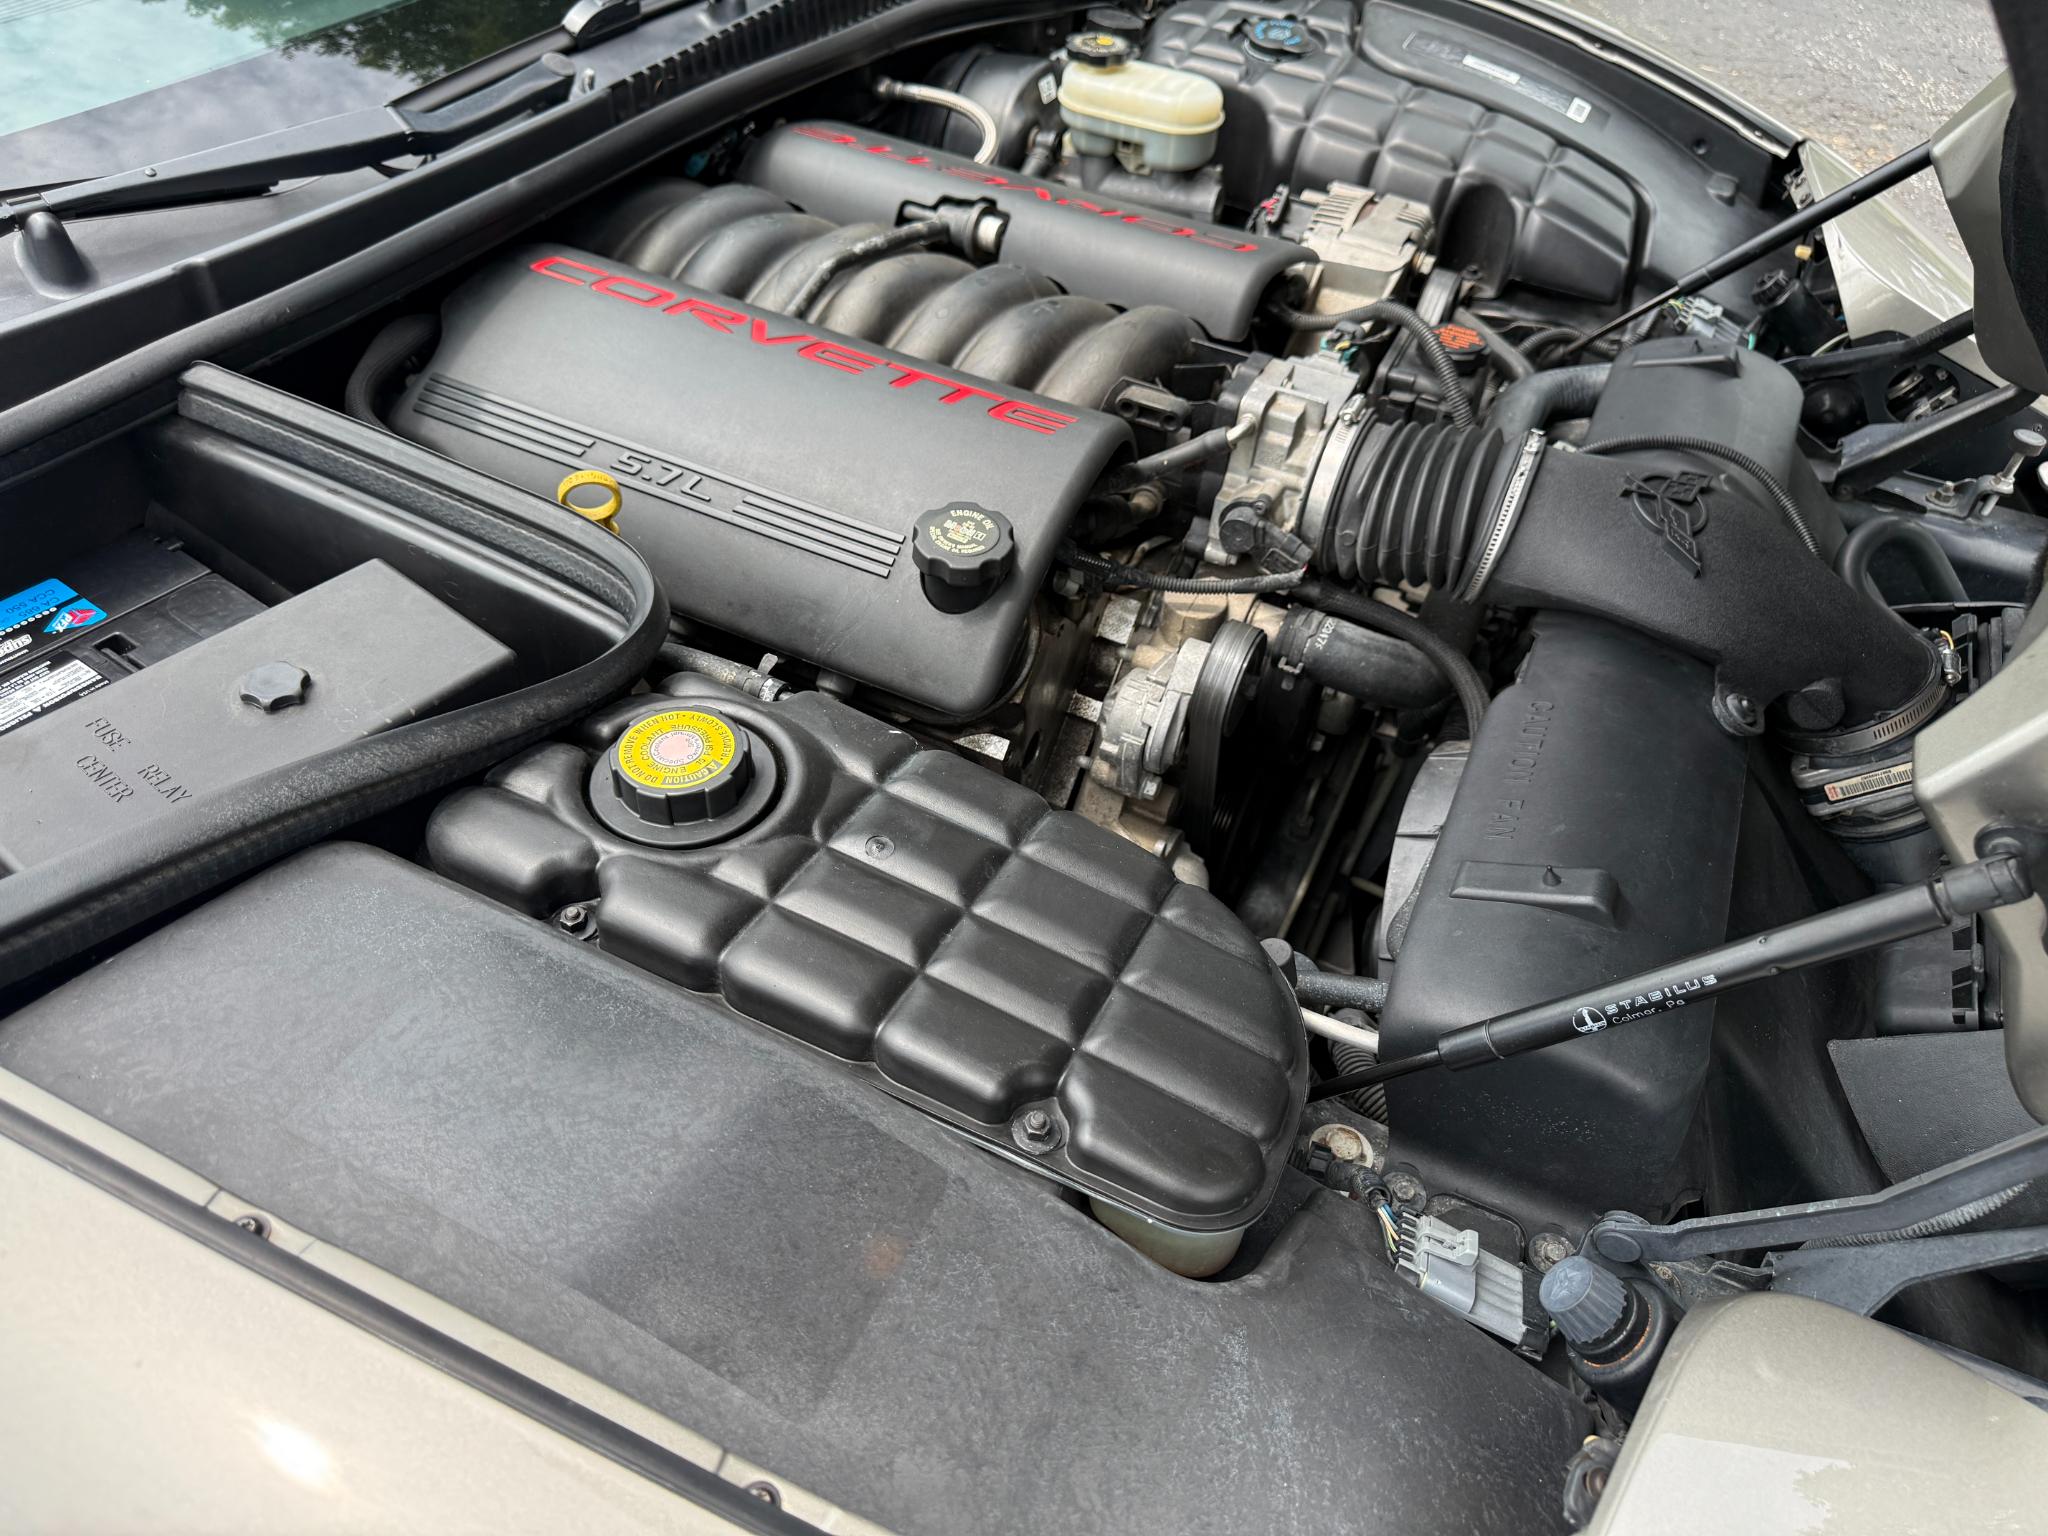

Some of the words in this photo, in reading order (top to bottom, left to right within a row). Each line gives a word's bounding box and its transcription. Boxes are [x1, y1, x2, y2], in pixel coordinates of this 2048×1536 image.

[529, 255, 1078, 435] CORVETTE
[610, 451, 711, 502] 5.7L
[950, 509, 985, 521] ENGINE
[982, 519, 995, 530] OIL
[30, 589, 56, 603] CCA
[42, 596, 60, 607] CA
[635, 718, 660, 735] WHEN
[661, 713, 680, 722] HOT
[689, 714, 723, 731] SLOWLY
[640, 728, 665, 761] COOLANT
[671, 724, 712, 746] PRESSURE
[1504, 701, 1555, 783] CAUTION
[624, 733, 637, 764] REMOVE
[85, 717, 131, 752] FUSE
[137, 763, 192, 803] RELAY
[627, 763, 645, 777] NOT
[648, 762, 687, 774] ENGINE
[77, 754, 134, 802] CENTER
[644, 774, 659, 783] DO
[665, 769, 709, 784] CAUTION
[1484, 799, 1525, 840] FAN
[1604, 974, 1718, 1015] STABILUS
[1666, 999, 1685, 1008] Pa
